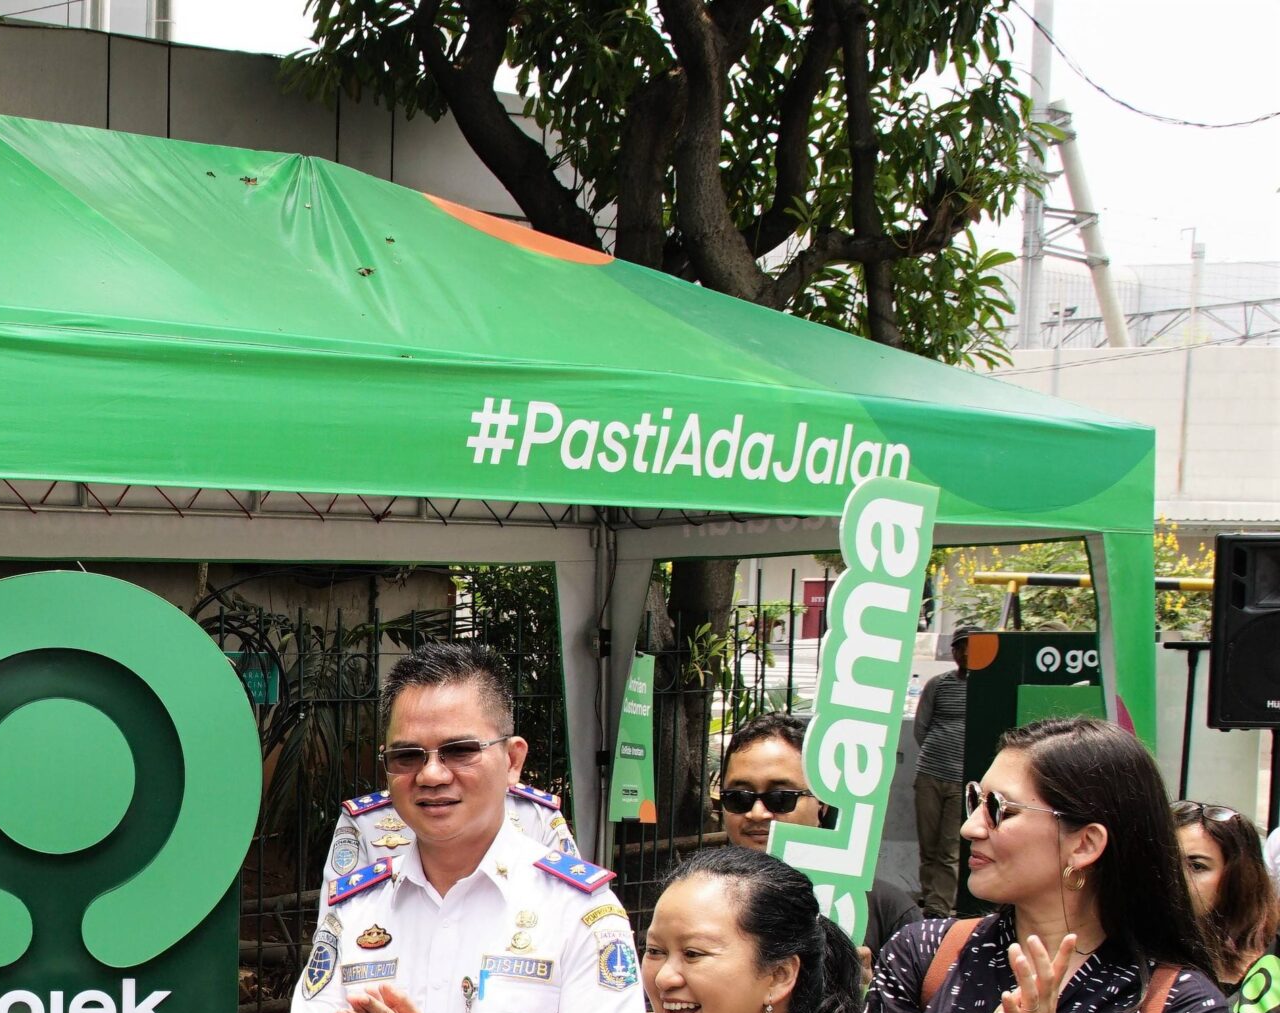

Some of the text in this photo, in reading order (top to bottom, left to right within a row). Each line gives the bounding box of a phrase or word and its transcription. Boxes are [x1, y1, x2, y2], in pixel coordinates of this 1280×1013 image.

[466, 397, 911, 485] #PastiAdaJalan
[1065, 649, 1099, 674] go
[485, 958, 548, 976] DISHUB
